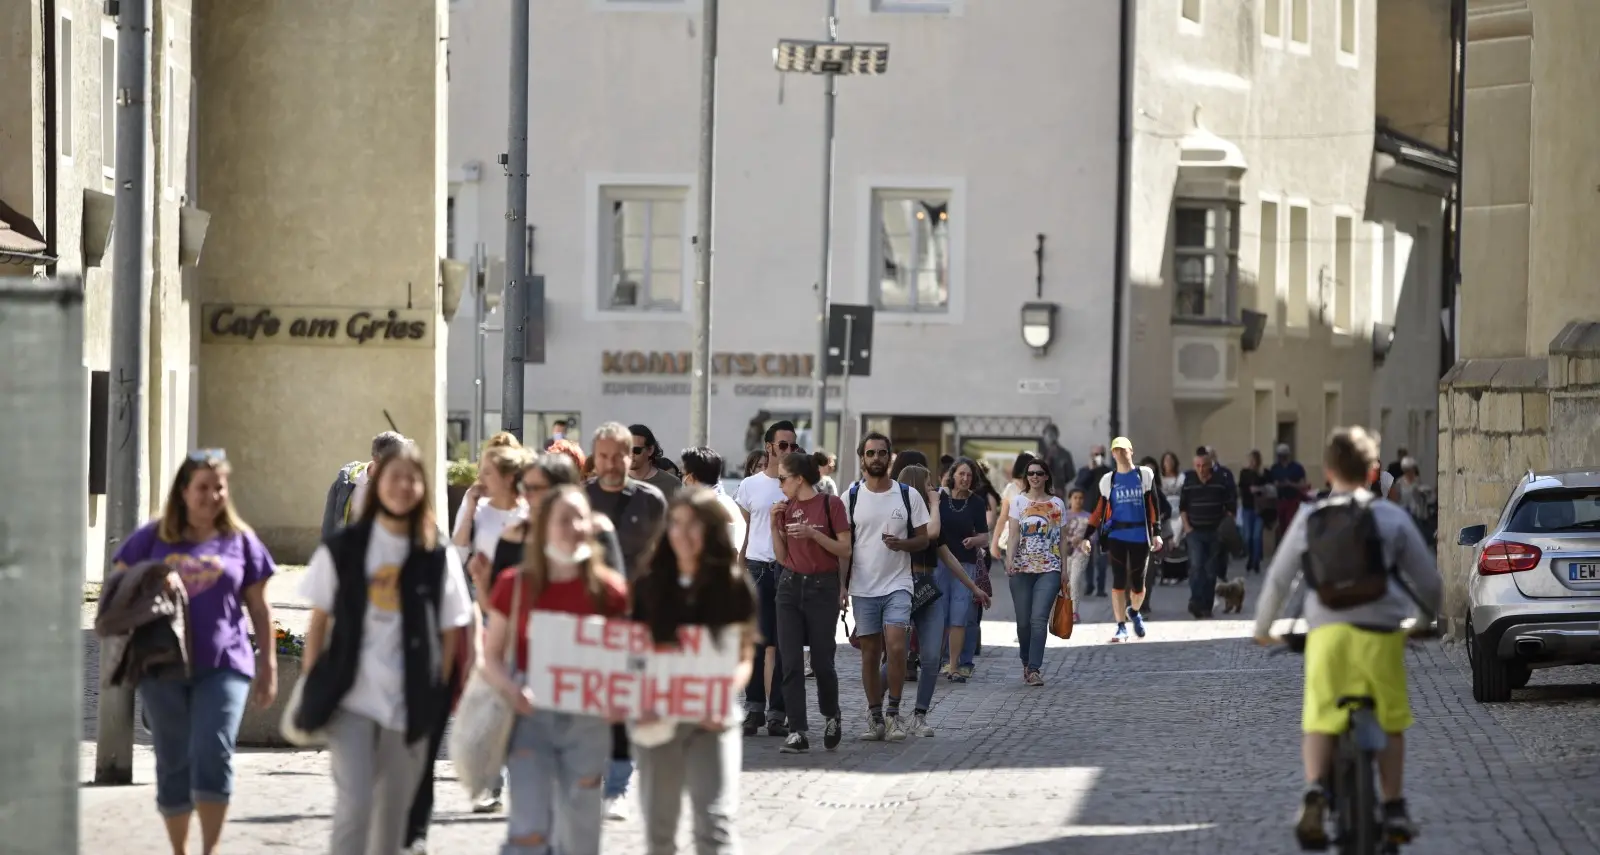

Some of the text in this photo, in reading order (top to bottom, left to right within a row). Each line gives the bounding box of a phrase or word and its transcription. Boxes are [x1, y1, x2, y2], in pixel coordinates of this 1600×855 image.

[210, 307, 426, 344] Cafe am Gries
[1580, 564, 1596, 578] EW
[574, 614, 703, 656] LEBN
[548, 665, 733, 717] FREIHEIT
